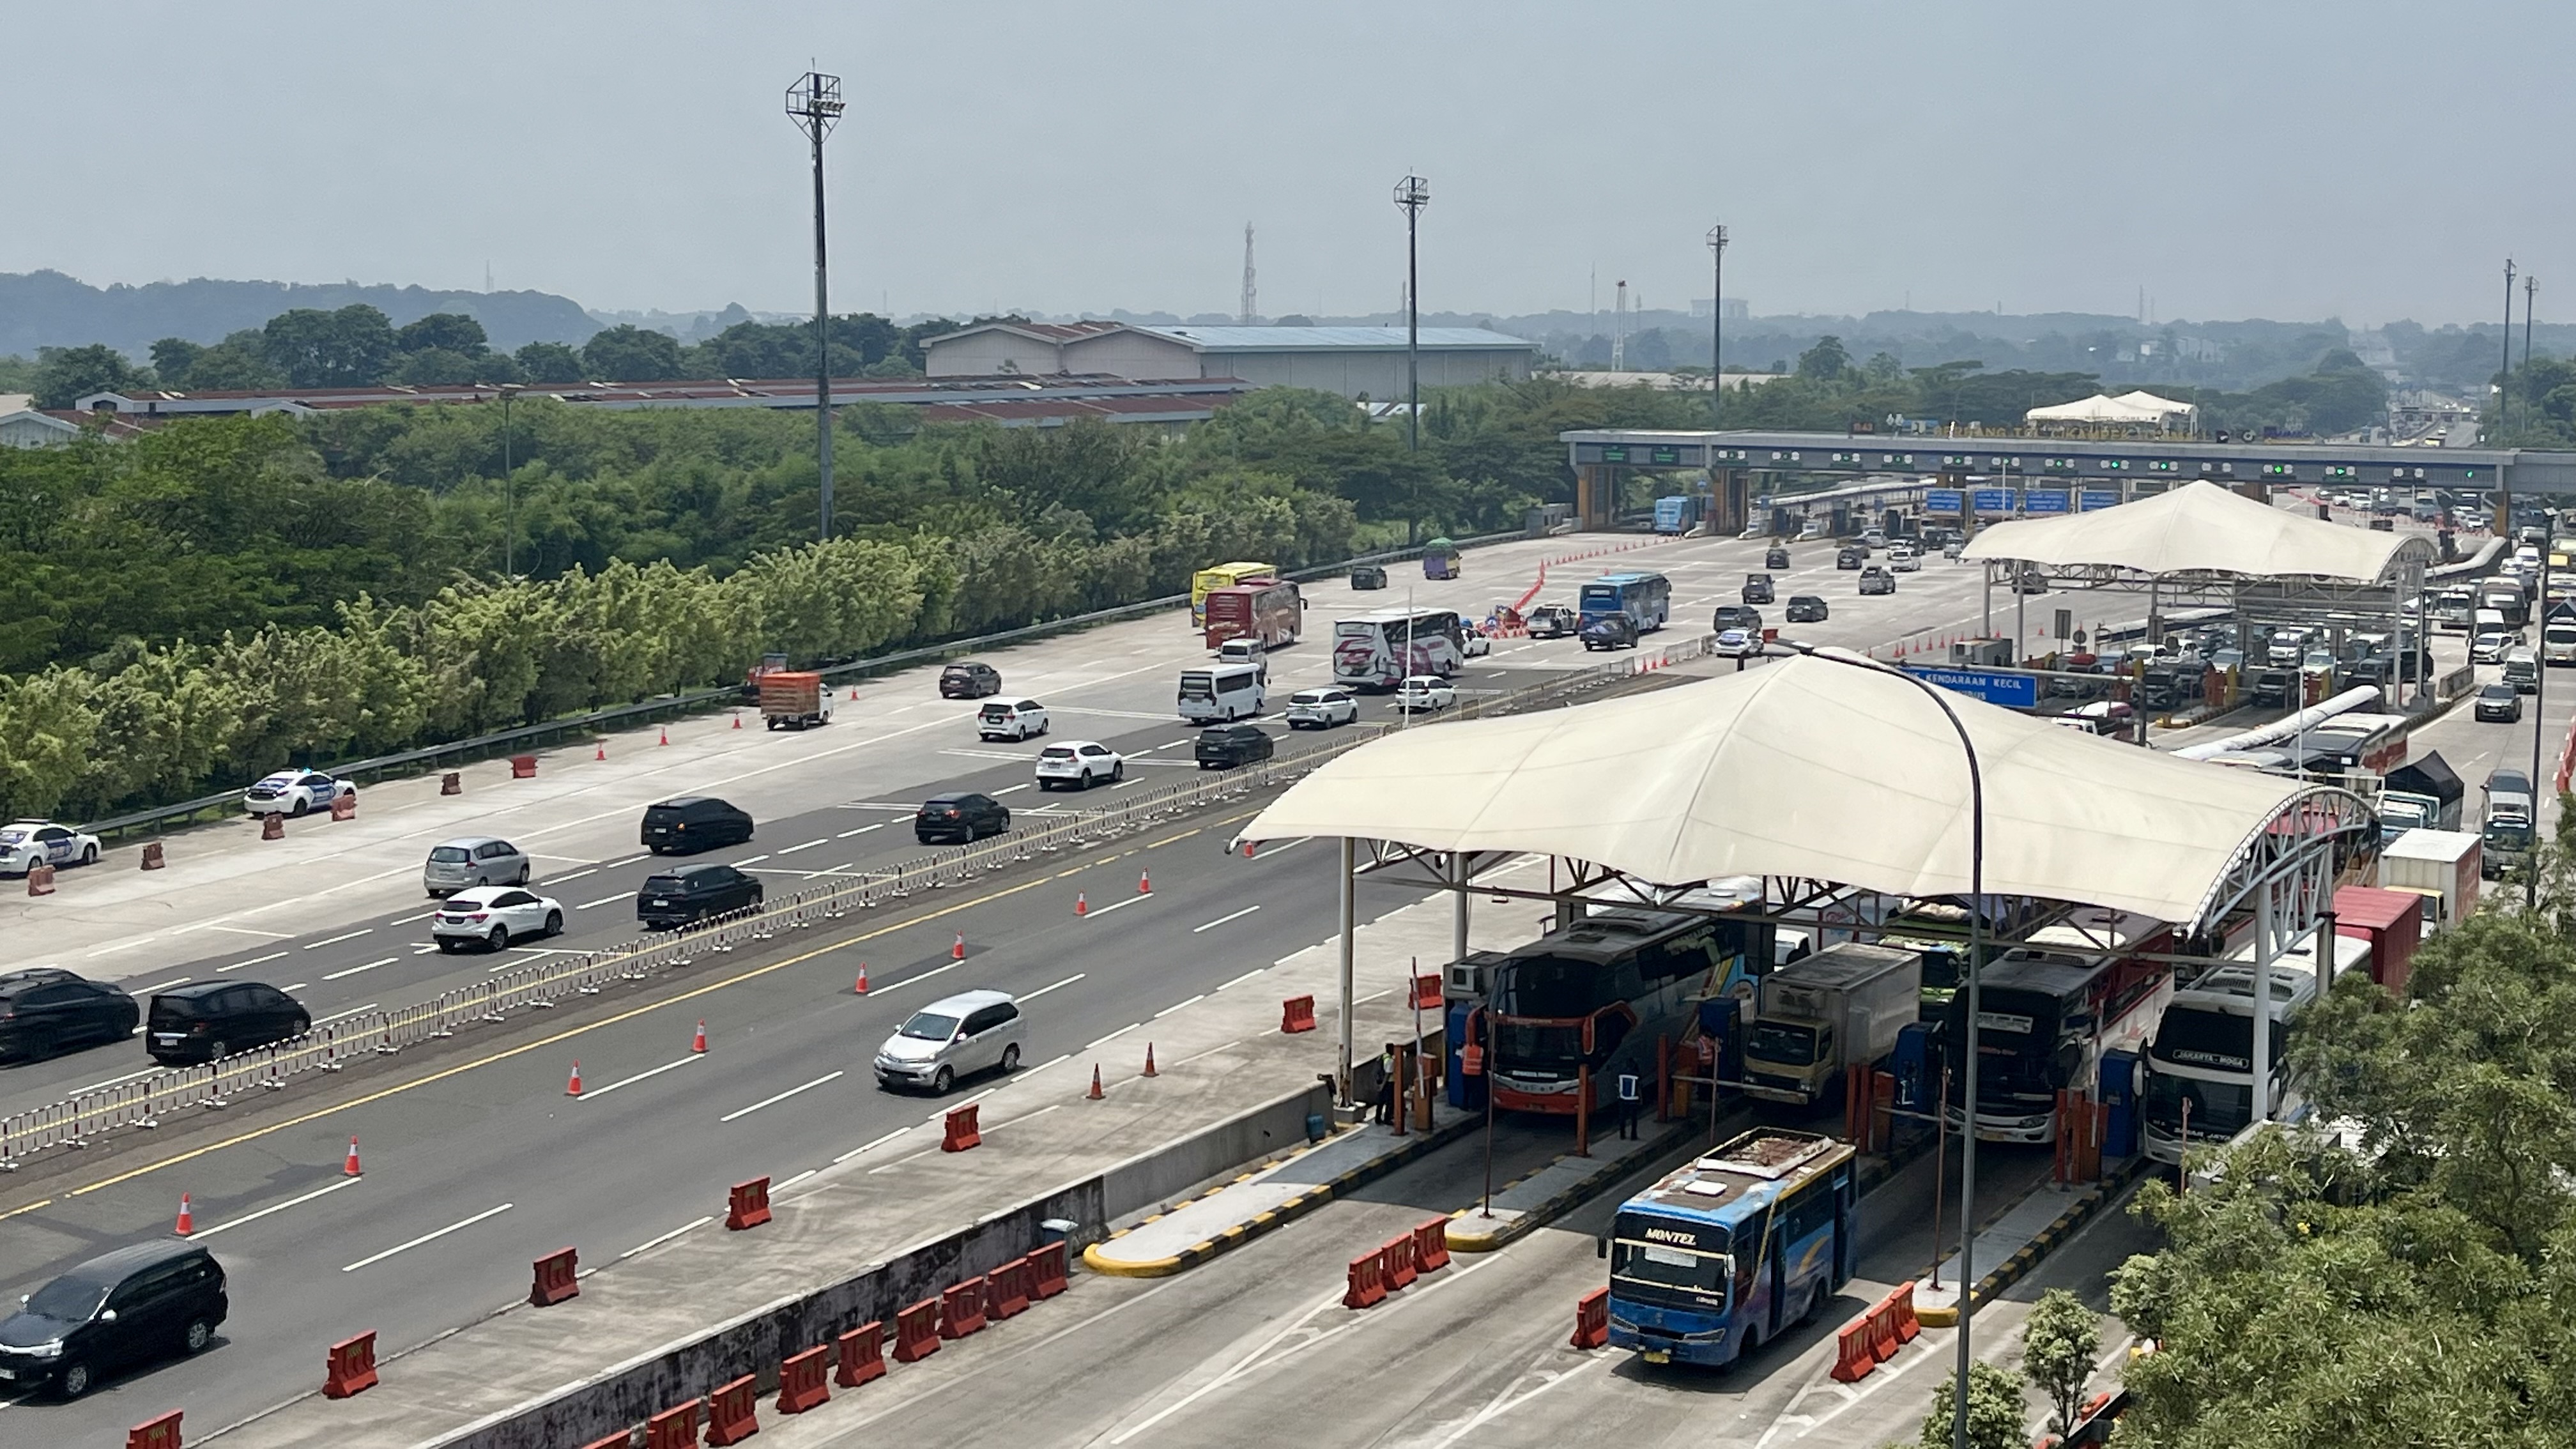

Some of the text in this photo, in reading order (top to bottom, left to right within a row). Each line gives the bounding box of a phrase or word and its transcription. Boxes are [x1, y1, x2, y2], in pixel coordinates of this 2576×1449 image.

[1926, 674, 1986, 686] KENDARAAN
[1993, 677, 2021, 689] KECIL
[2177, 1051, 2212, 1062] JAKARTA
[1645, 1228, 1697, 1245] MONTEL
